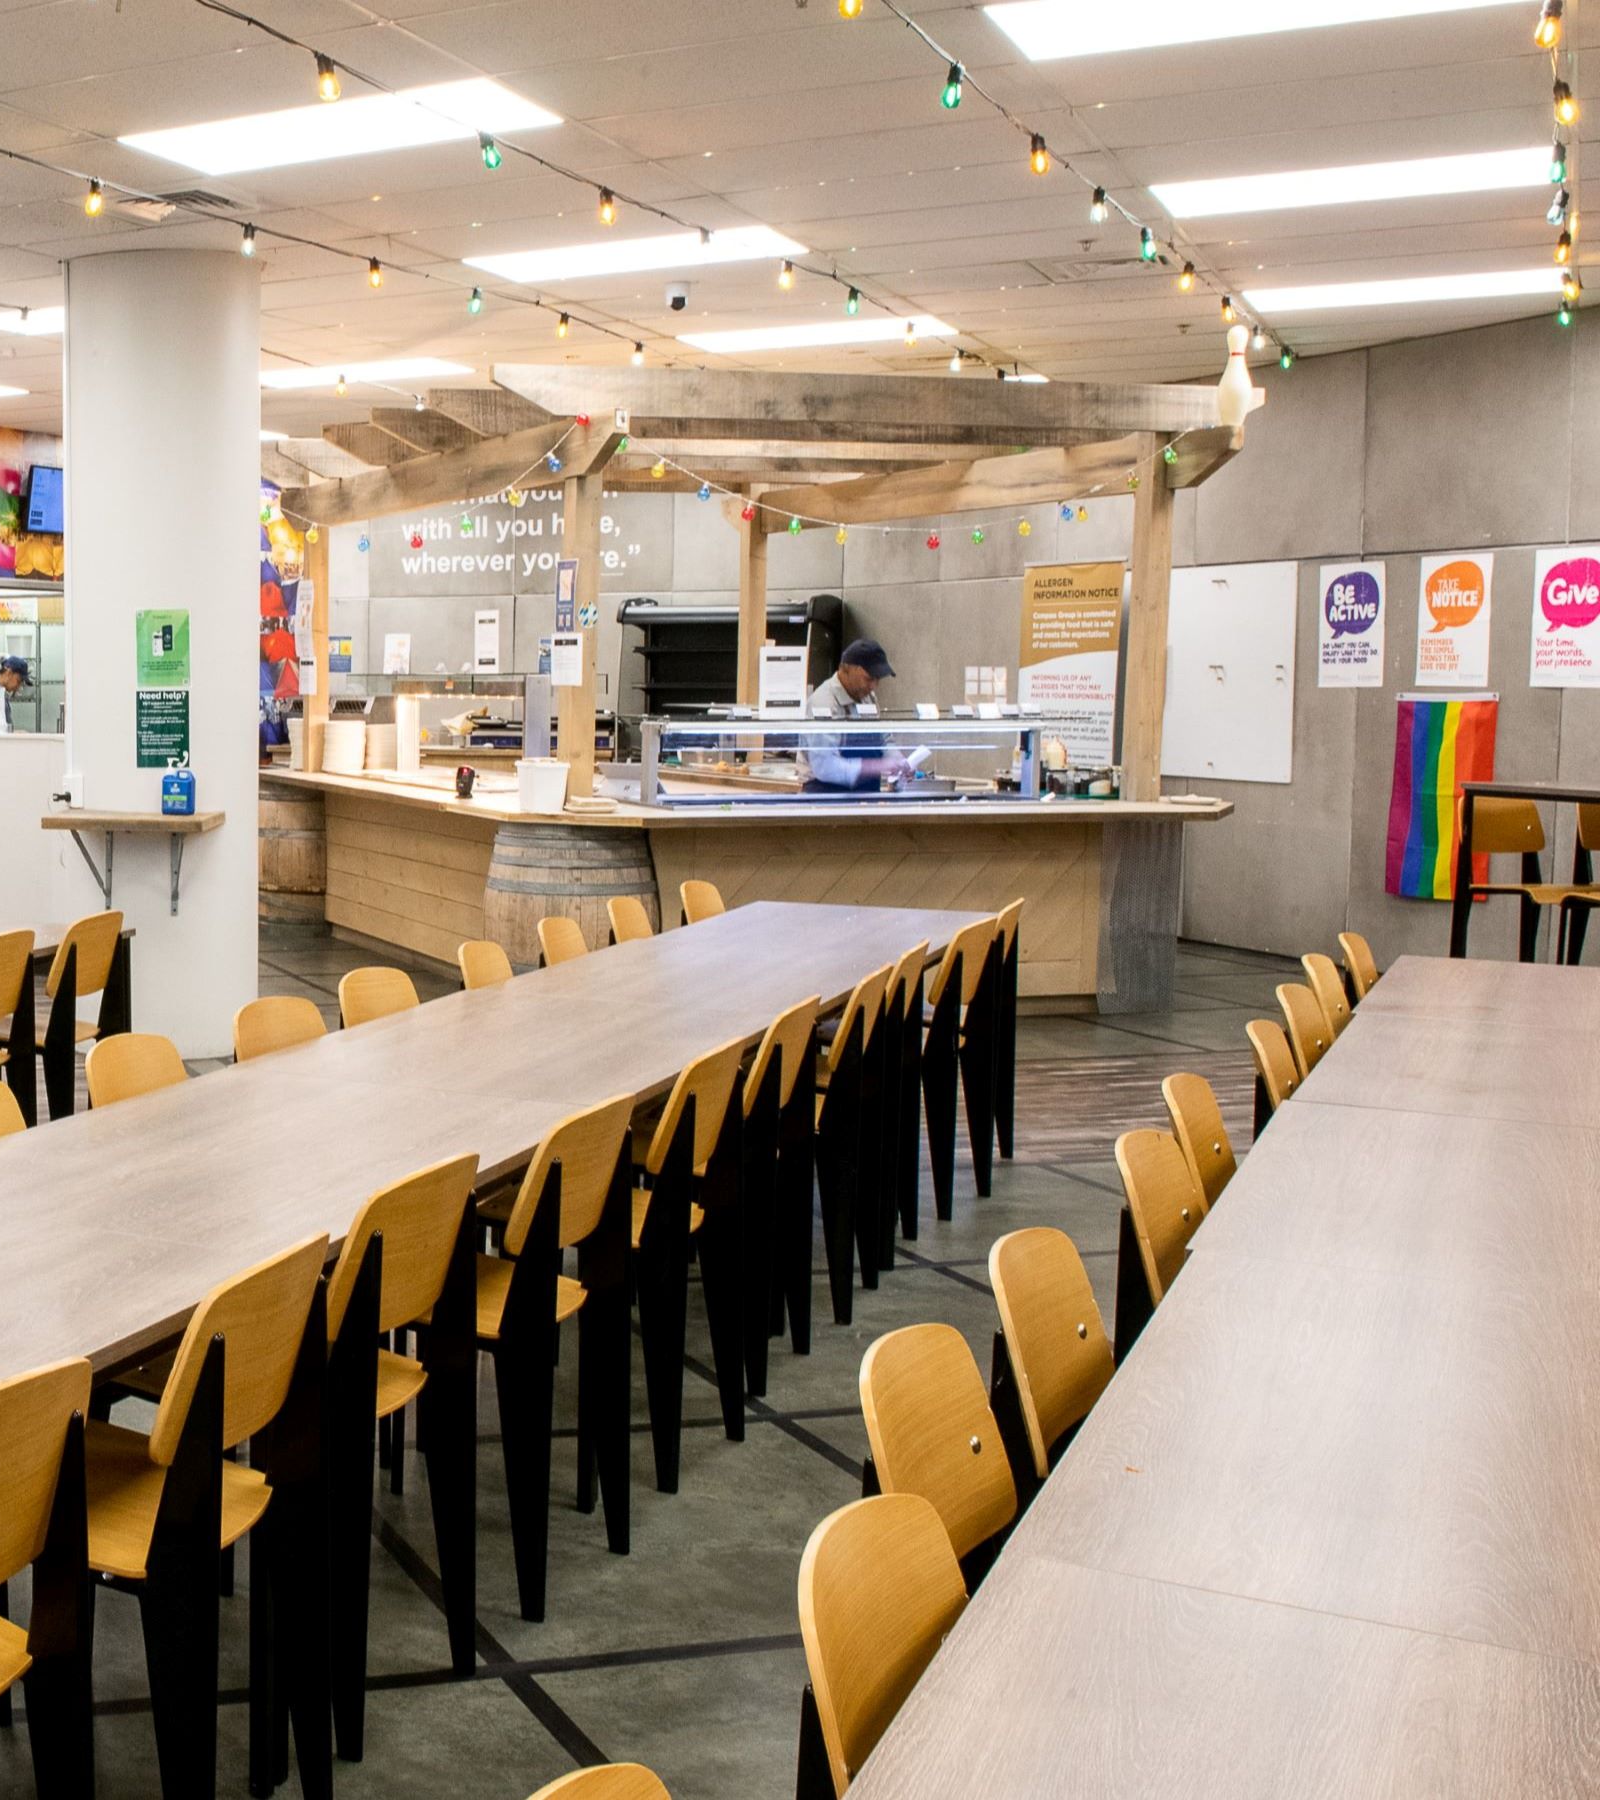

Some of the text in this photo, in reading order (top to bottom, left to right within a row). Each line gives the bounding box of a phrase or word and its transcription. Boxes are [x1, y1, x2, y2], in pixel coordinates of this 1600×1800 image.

[401, 517, 452, 541] with
[496, 517, 543, 544] you
[552, 512, 621, 537] he,
[401, 550, 515, 575] wherever
[1034, 577, 1073, 588] ALLERGEN
[1437, 577, 1460, 592] TAKE
[1033, 587, 1120, 600] INFORMATION NOTICE
[1333, 583, 1356, 606] BE
[1546, 577, 1600, 606] Give
[1431, 589, 1479, 608] NOTICE
[1058, 610, 1076, 620] Group
[1082, 609, 1117, 618] committed
[1329, 602, 1377, 622] ACTIVE
[1039, 621, 1066, 631] providing
[1066, 620, 1081, 629] food
[1081, 620, 1093, 628] that
[1071, 630, 1110, 640] expectations
[1347, 641, 1357, 649] YOU
[1536, 637, 1553, 647] Your
[1421, 646, 1432, 654] THE
[1536, 649, 1553, 659] your
[1536, 659, 1593, 669] your presence
[139, 691, 187, 701] Need help?
